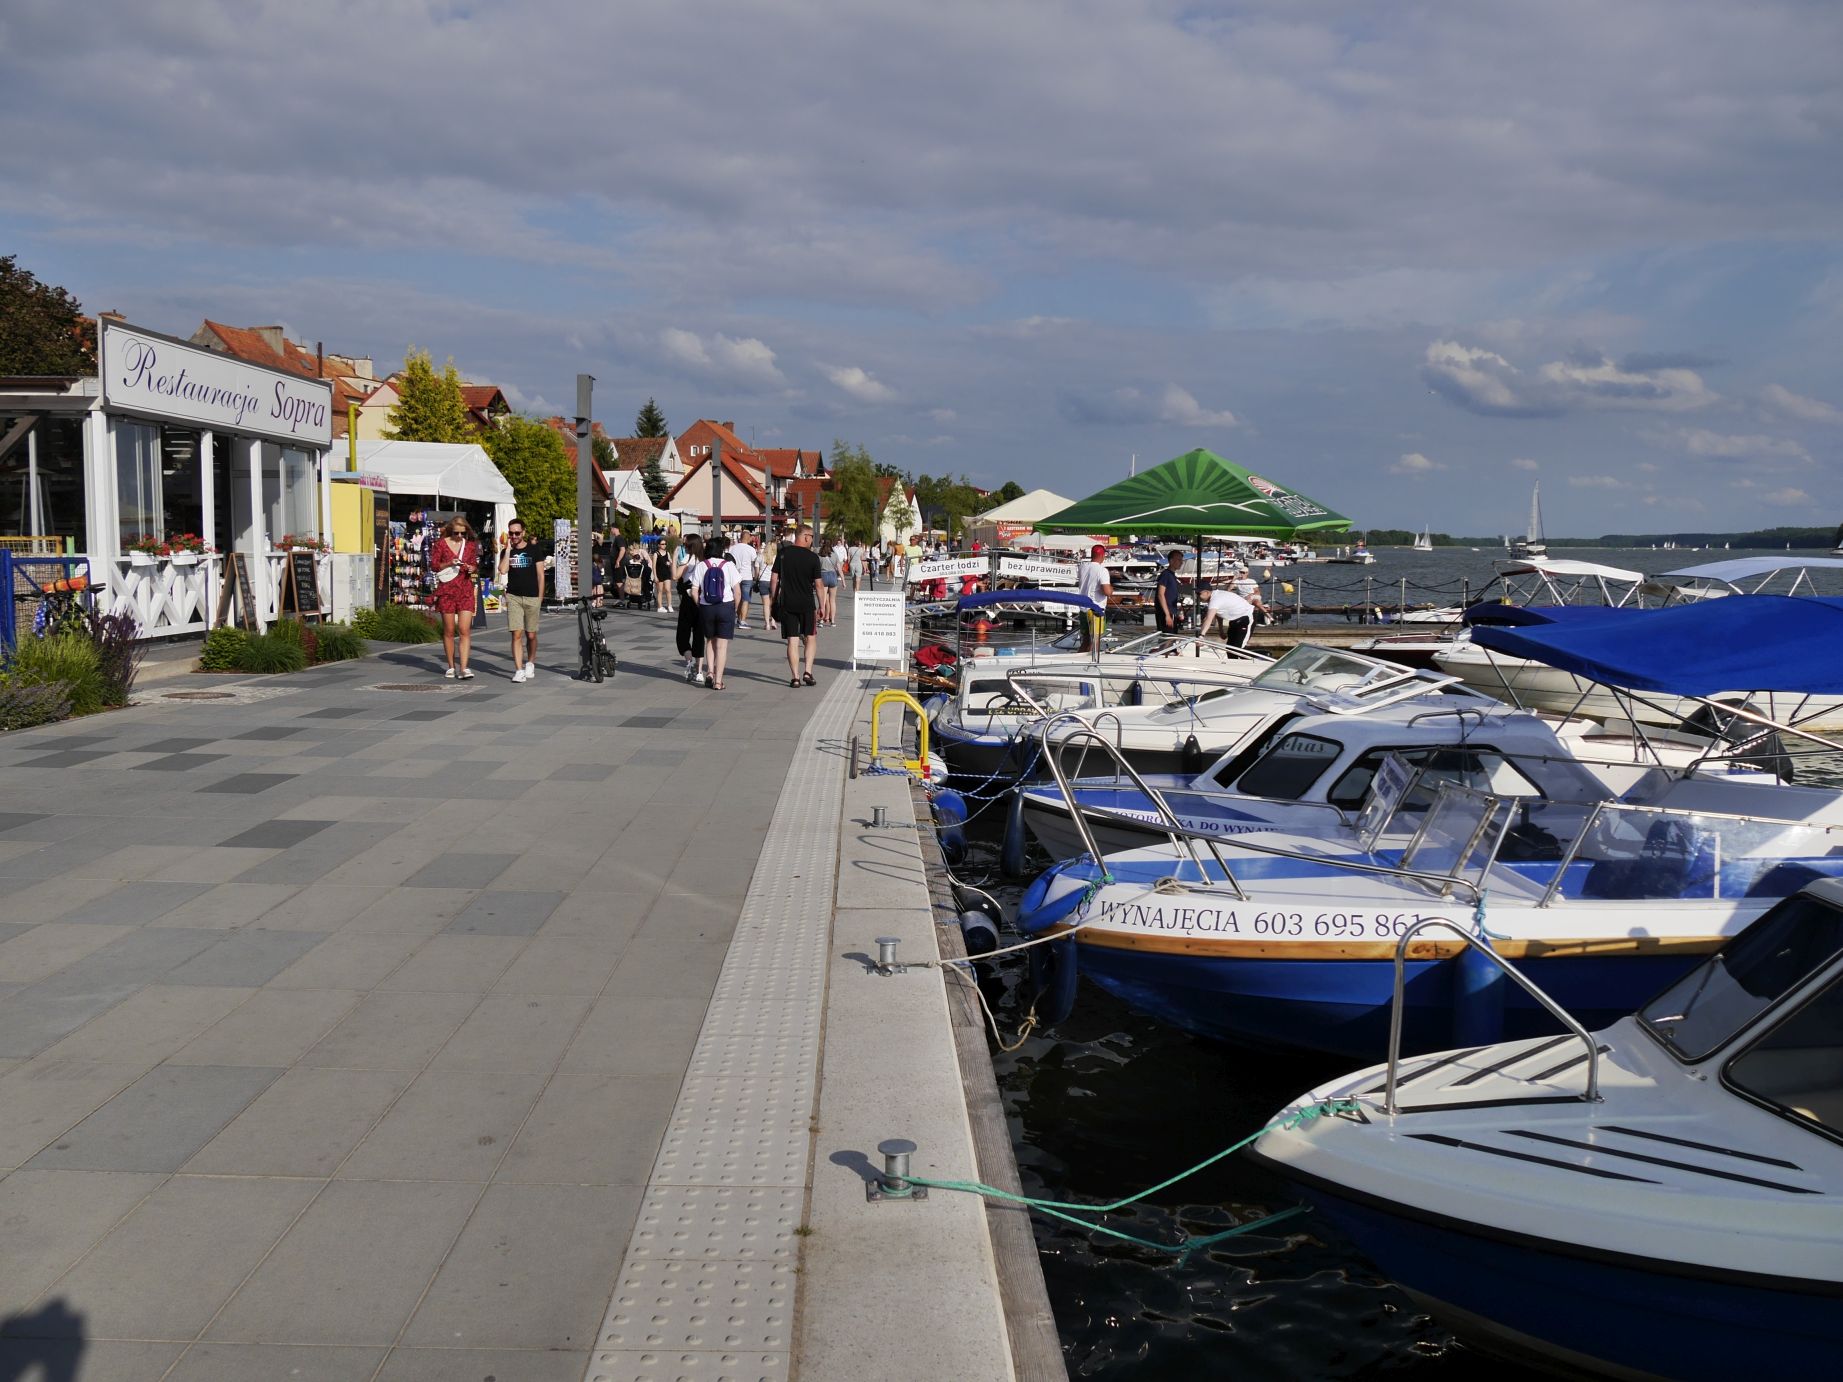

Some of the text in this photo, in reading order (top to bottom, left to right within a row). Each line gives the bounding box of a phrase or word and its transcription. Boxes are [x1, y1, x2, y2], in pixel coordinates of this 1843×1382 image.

[121, 338, 325, 433] Restauracja Sopra
[920, 561, 980, 573] Czarter łodzi
[1007, 561, 1072, 575] bez uprawnień
[1200, 821, 1219, 831] DO
[1100, 900, 1240, 936] WYNAJĘCIA
[1254, 911, 1303, 936] 603
[1314, 913, 1365, 937] 695
[1375, 914, 1424, 937] 861
